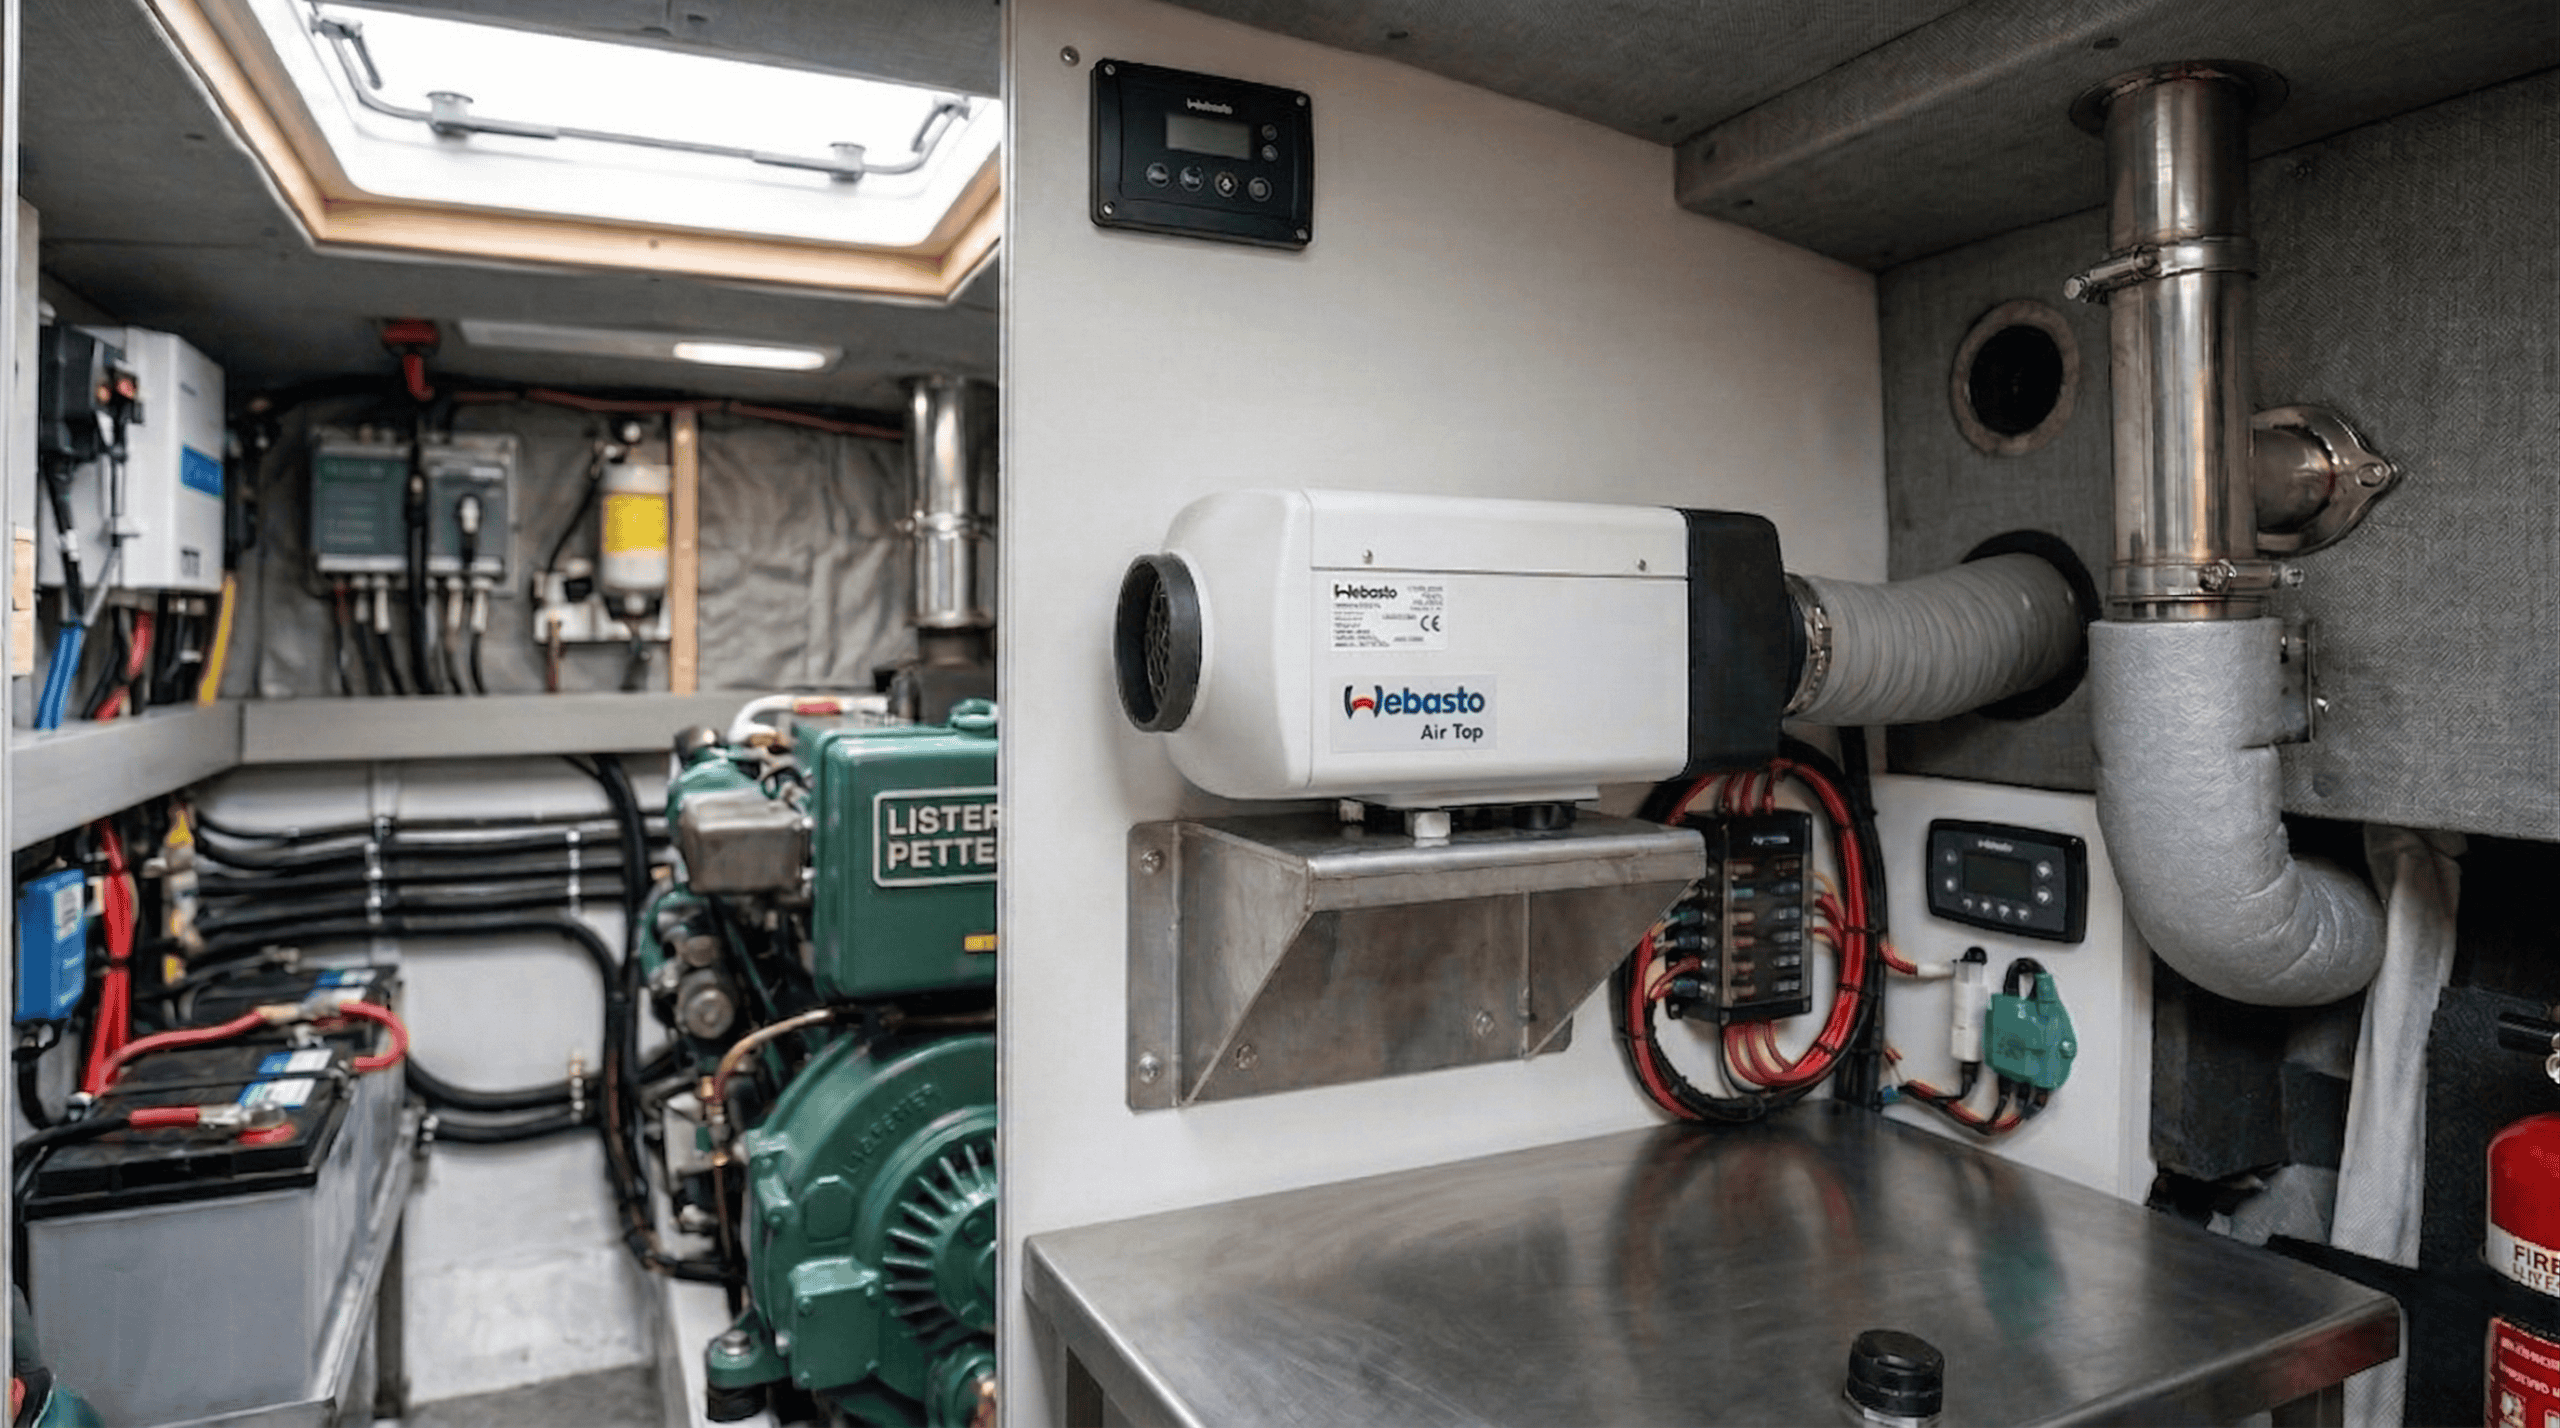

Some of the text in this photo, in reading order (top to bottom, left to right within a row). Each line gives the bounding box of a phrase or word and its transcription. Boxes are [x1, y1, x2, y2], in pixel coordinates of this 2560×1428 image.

[1334, 584, 1398, 599] Webasto
[1344, 685, 1485, 720] Webasto
[1421, 723, 1484, 743] Air Top
